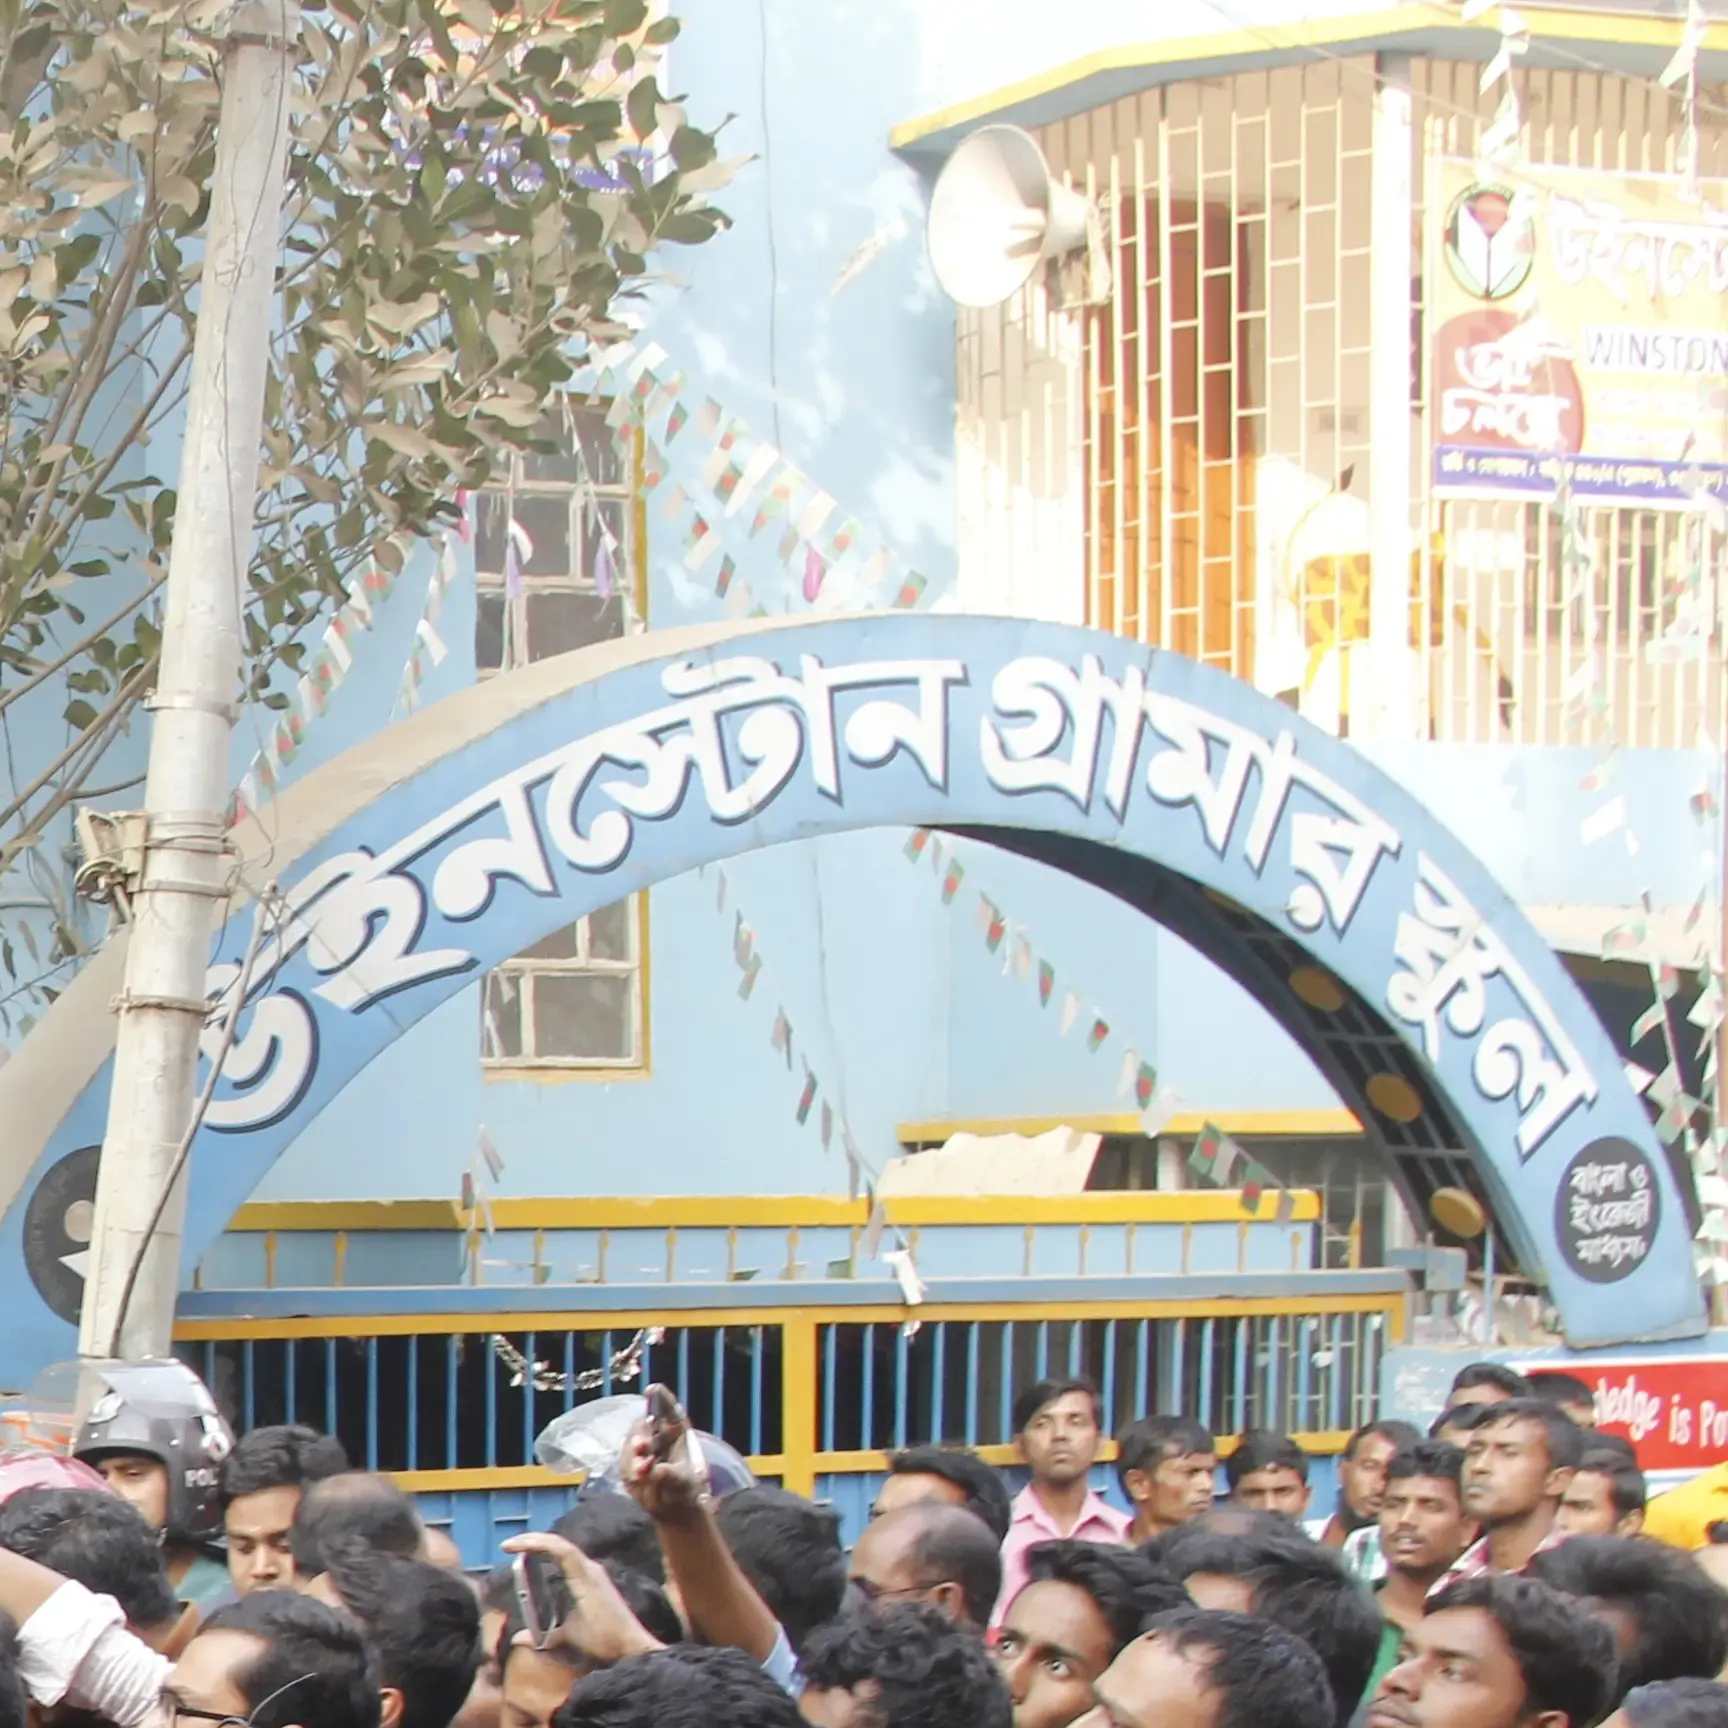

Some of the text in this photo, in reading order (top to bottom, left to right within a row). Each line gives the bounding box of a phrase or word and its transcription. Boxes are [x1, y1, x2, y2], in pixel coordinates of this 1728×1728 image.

[981, 655, 1399, 932] গ্রামার
[1387, 850, 1597, 1160] স্কুল
[1570, 1161, 1627, 1197] বাংলা
[1591, 1373, 1728, 1449] ledge is Po
